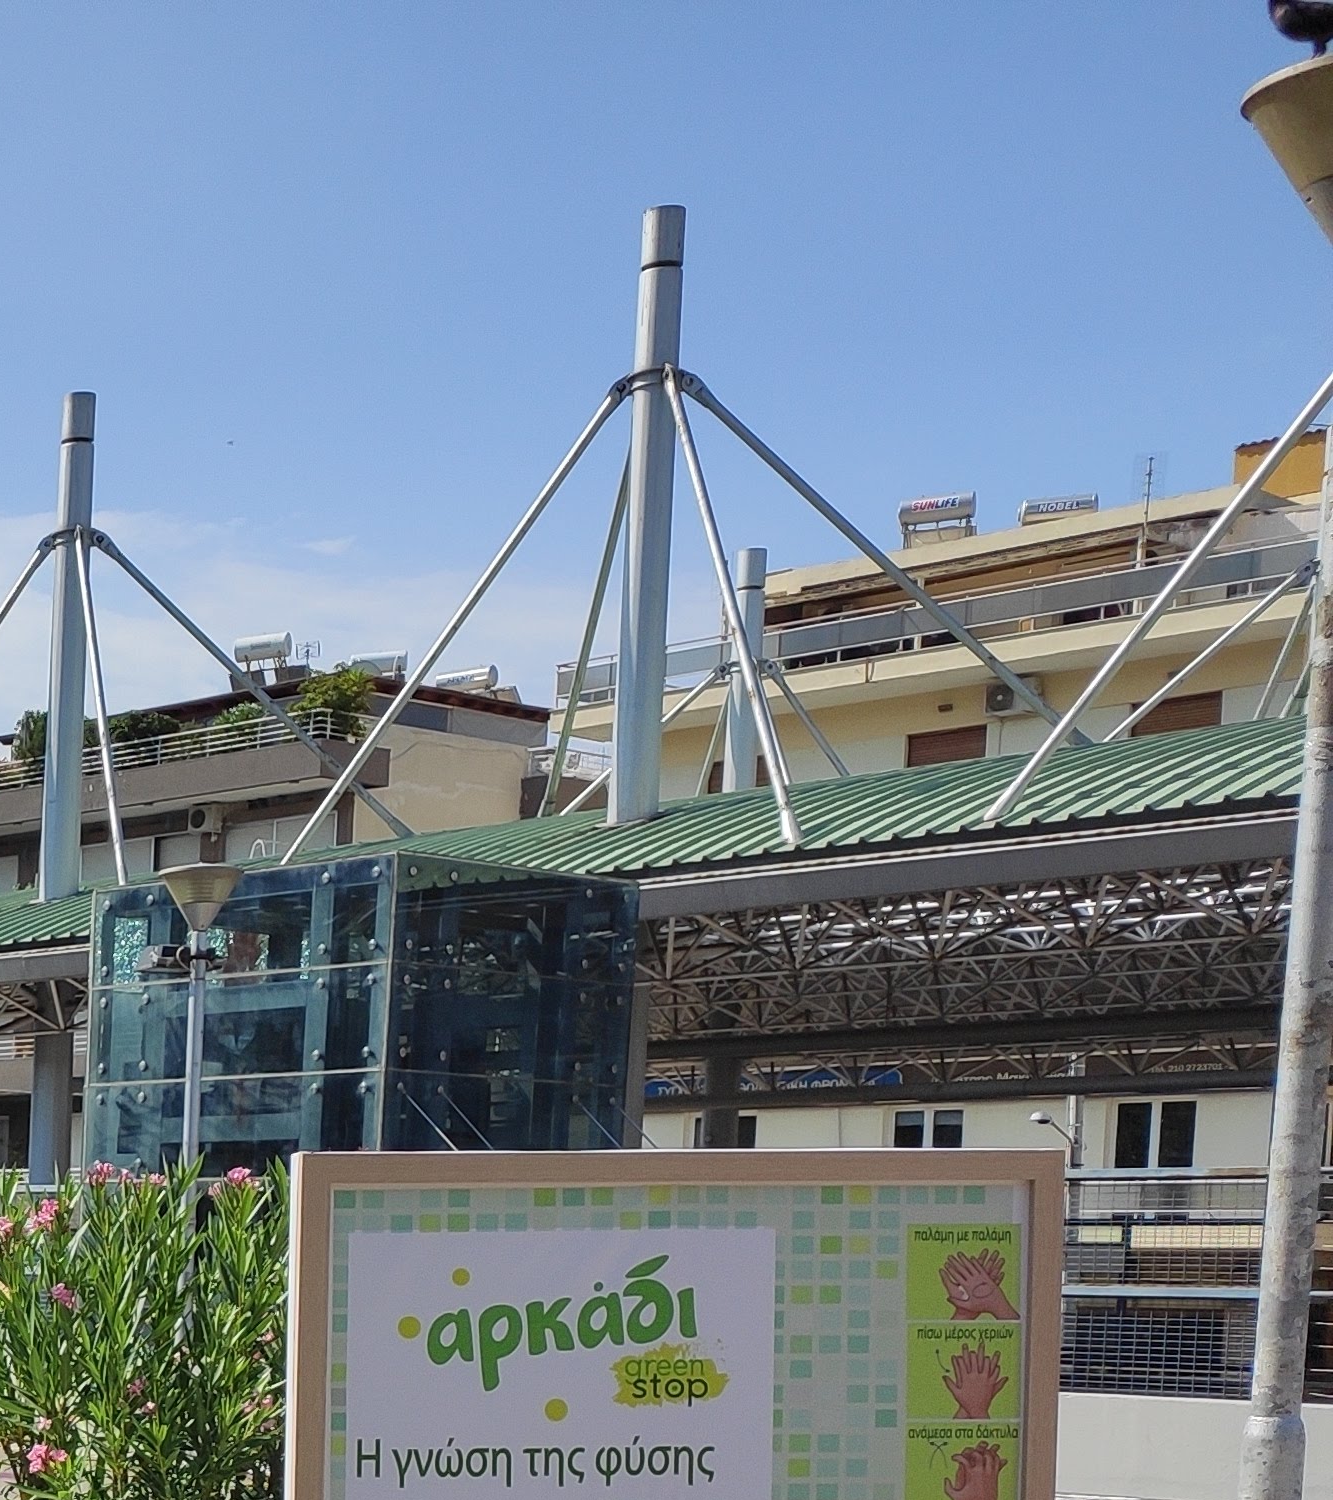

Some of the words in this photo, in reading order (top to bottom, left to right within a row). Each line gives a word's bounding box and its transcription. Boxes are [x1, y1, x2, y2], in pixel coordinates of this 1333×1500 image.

[912, 496, 959, 512] SUNLIFE
[1038, 500, 1080, 512] NOBEL
[914, 1226, 954, 1244] παλάμη
[957, 1230, 969, 1244] με
[972, 1226, 1012, 1244] παλάμη
[426, 1255, 698, 1391] αρκάδι
[917, 1325, 942, 1339] πίσω
[945, 1325, 977, 1341] μέρος
[979, 1325, 1014, 1342] χεριών
[625, 1358, 704, 1384] green
[632, 1373, 708, 1407] stop
[908, 1425, 952, 1441] ανάμεσα
[955, 1428, 973, 1439] στα
[976, 1424, 1018, 1439] δάκτυλα
[356, 1438, 381, 1478] Η
[391, 1437, 512, 1488] γνώση
[523, 1447, 585, 1487] της
[595, 1435, 715, 1486] φύσης
